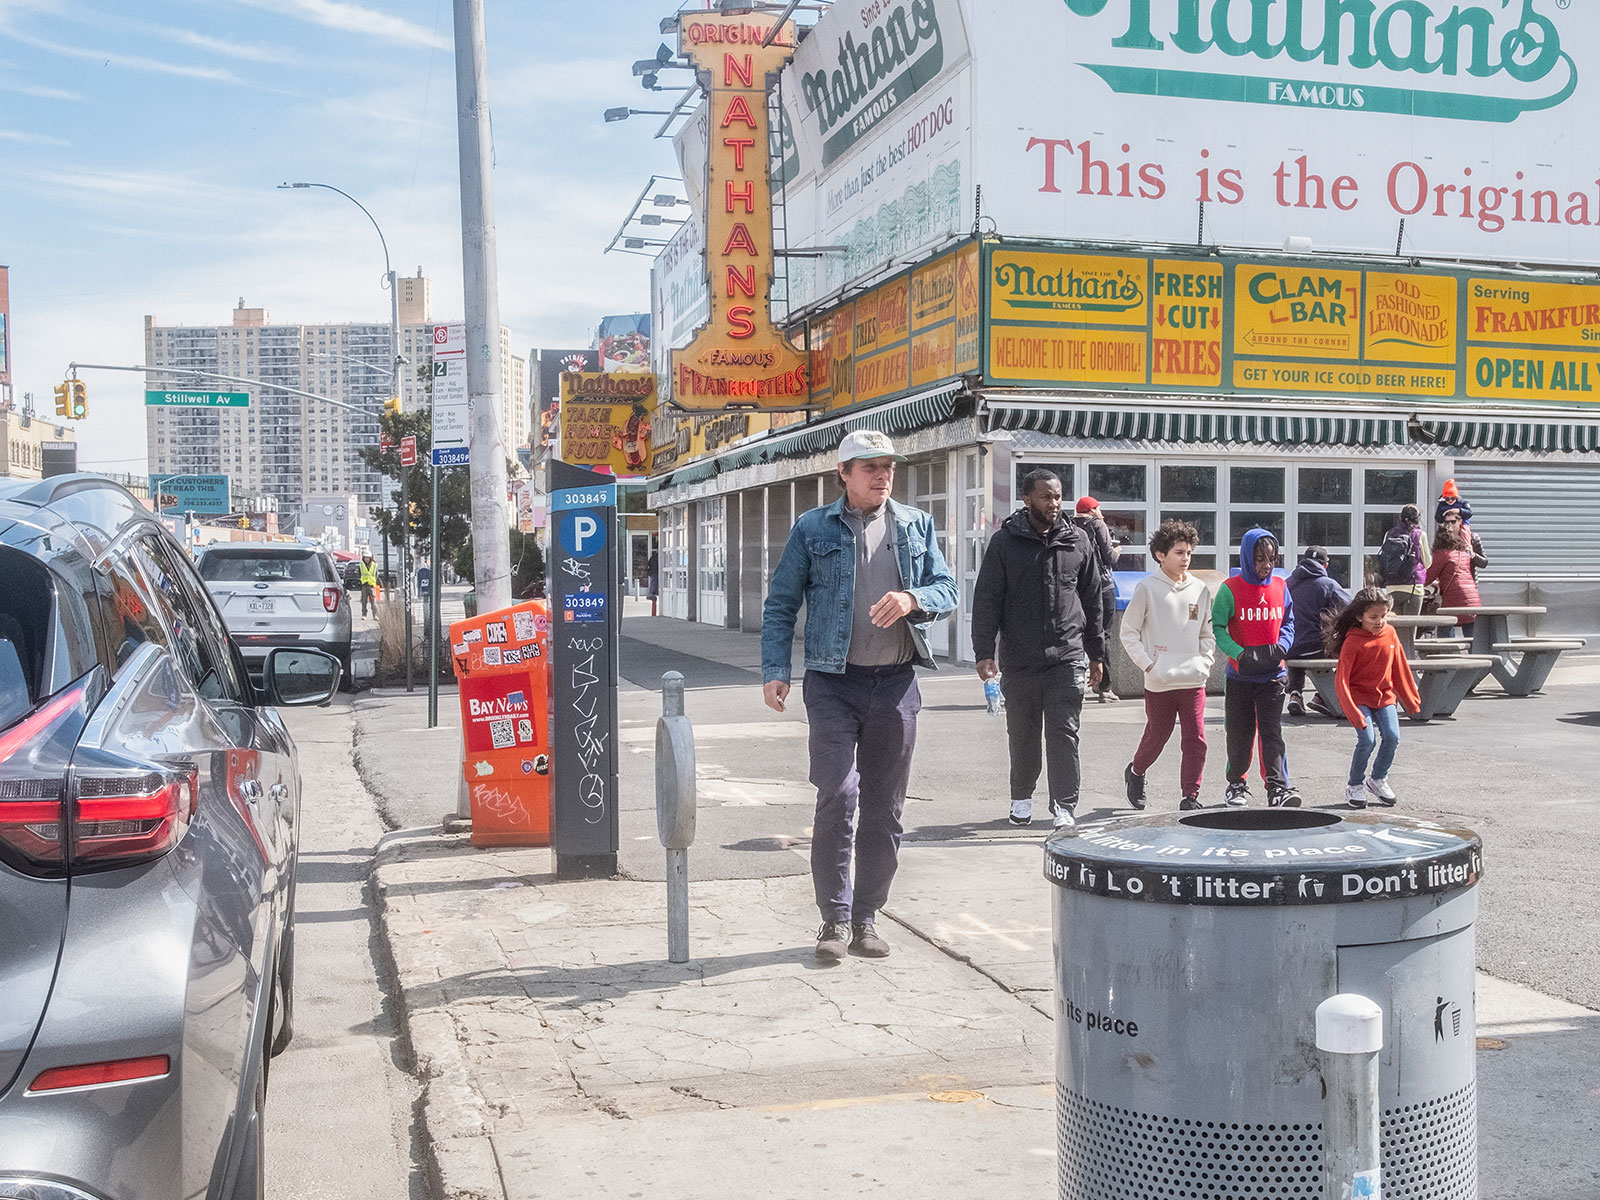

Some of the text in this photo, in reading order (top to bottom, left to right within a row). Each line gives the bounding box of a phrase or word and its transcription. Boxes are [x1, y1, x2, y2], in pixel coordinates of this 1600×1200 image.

[860, 1, 881, 29] Since
[1064, 0, 1562, 82] athans
[801, 0, 938, 136] Nathans
[1268, 81, 1364, 108] FAMOUS
[852, 88, 897, 137] FAMOUS
[827, 97, 953, 215] More than just the best HOT DOG
[1025, 137, 1166, 200] This
[1196, 149, 1244, 204] is
[1273, 155, 1359, 210] the
[720, 53, 758, 339] NATHANS
[995, 262, 1140, 301] Nathan's
[1155, 272, 1222, 299] FRESH
[1249, 272, 1342, 304] CLAM
[1395, 279, 1421, 299] OLD
[1474, 285, 1530, 304] Serving
[1168, 305, 1209, 329] CUT
[1290, 301, 1346, 327] BAR
[1376, 295, 1441, 321] FASHIONED
[856, 317, 877, 348] FRIES
[958, 313, 977, 337] ORDER
[1369, 309, 1449, 342] LEMONADE
[1252, 336, 1347, 346] AROUND THE CORNER
[711, 352, 775, 366] FAMOUS
[996, 337, 1141, 373] WELCOME TO THE ORIGINAL!
[1153, 338, 1221, 376] FRIES
[436, 362, 444, 375] 2
[680, 363, 808, 396] FRANKFURTERS
[855, 351, 908, 394] ROOT BEER
[1243, 368, 1446, 389] GET YOUR ICE COLD BEER HERE!
[1475, 357, 1593, 392] OPEN ALL
[563, 372, 654, 396] Nathan's
[165, 394, 231, 404] Stillwell Av
[566, 408, 612, 423] TAKE
[564, 424, 612, 440] HOME
[439, 453, 465, 464] 303849
[564, 441, 611, 459] FOOD
[565, 493, 607, 504] 303849
[575, 516, 597, 551] P
[565, 598, 604, 608] 303849
[1240, 606, 1283, 621] JORDAN
[521, 643, 539, 653] RUN
[469, 697, 529, 716] BAY News
[1089, 836, 1368, 859] litter in its place
[1196, 876, 1275, 899] litter
[1342, 869, 1418, 896] Don't
[1428, 862, 1469, 887] litter
[1066, 998, 1082, 1024] its
[1087, 1010, 1139, 1037] place
